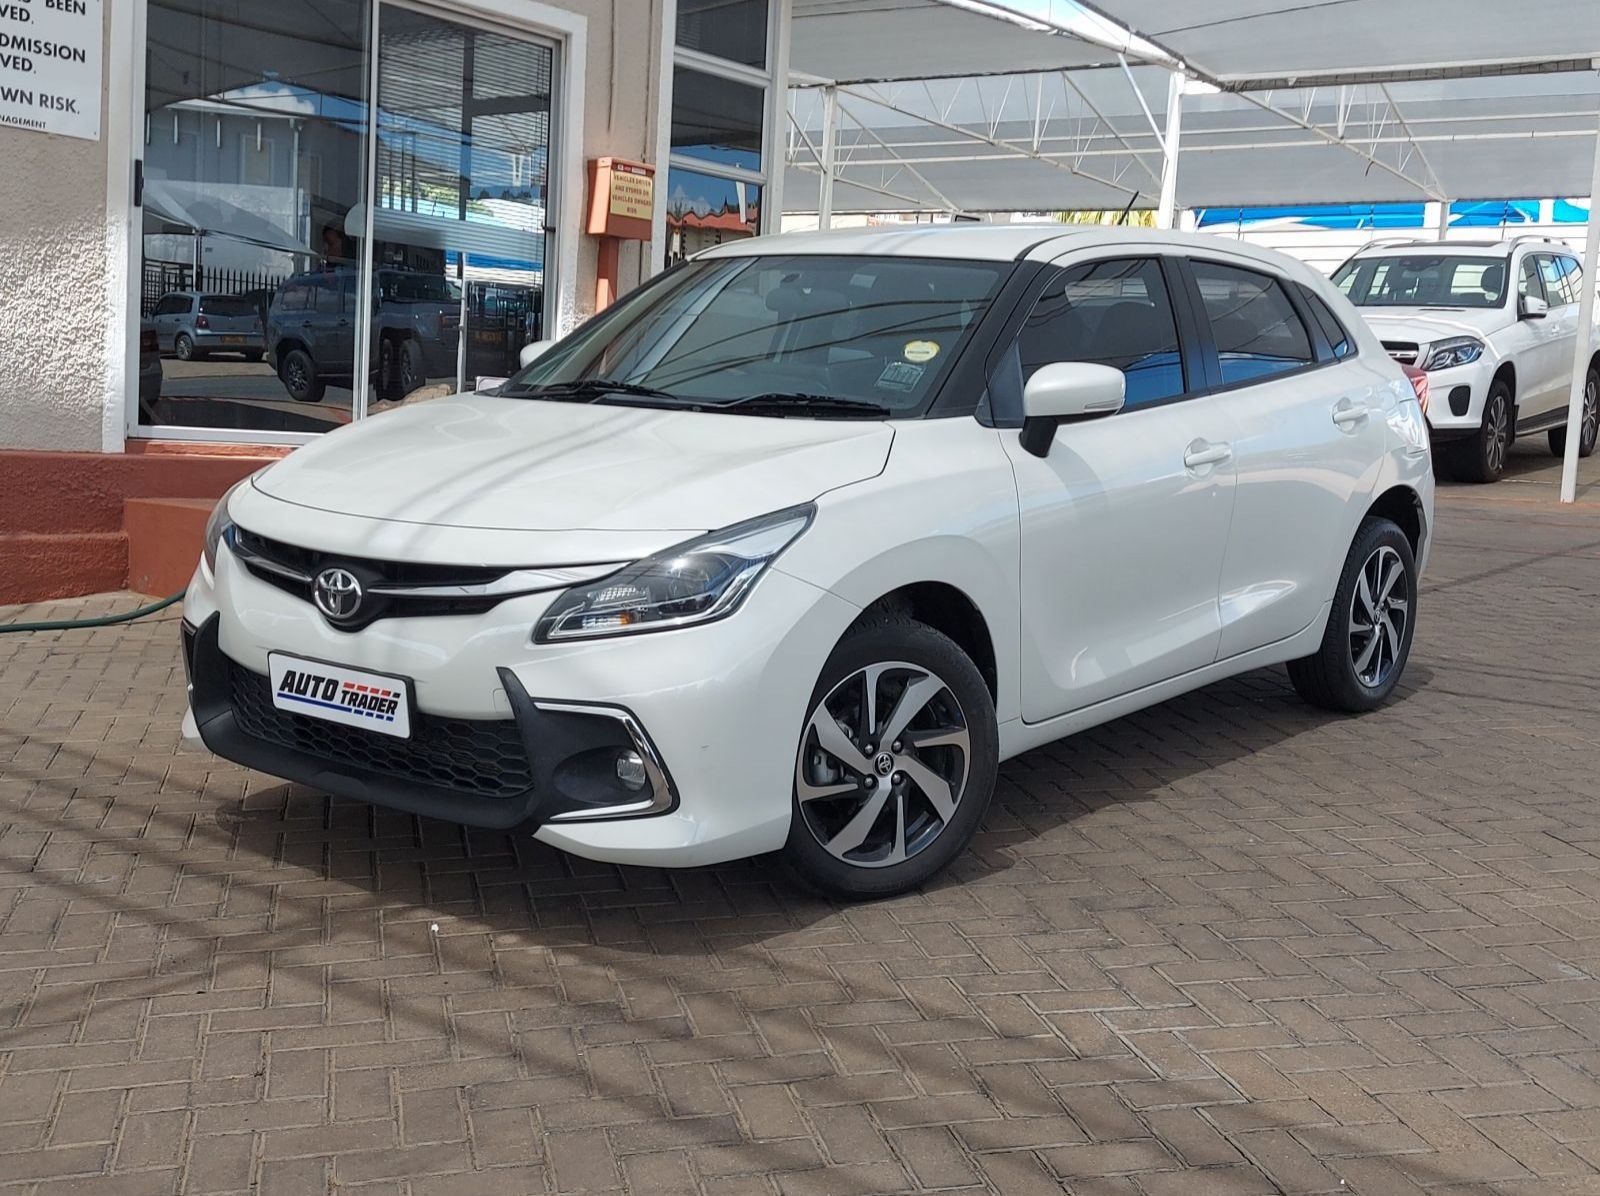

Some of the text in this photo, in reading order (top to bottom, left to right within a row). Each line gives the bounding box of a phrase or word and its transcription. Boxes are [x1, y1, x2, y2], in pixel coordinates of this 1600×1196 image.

[45, 0, 86, 16] BEEN
[0, 86, 80, 115] WN RISK.
[279, 670, 398, 715] AUTO TRADER
